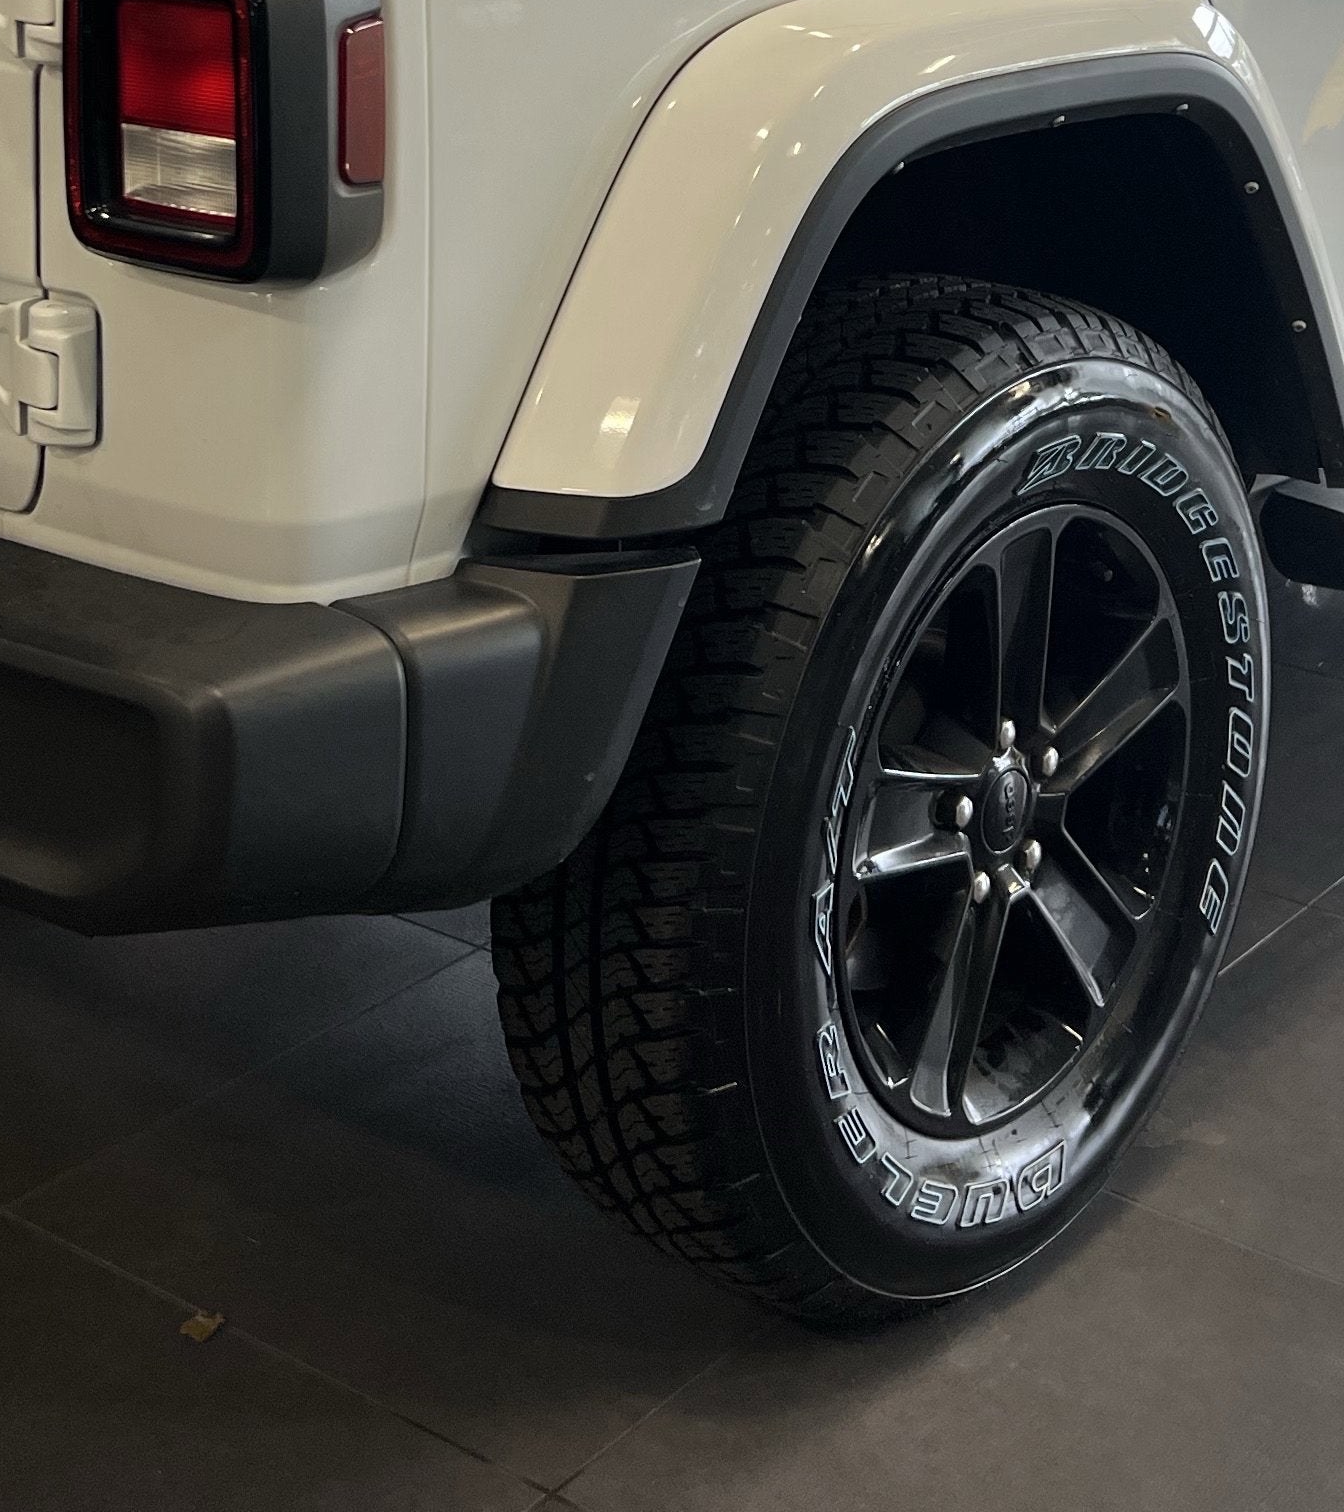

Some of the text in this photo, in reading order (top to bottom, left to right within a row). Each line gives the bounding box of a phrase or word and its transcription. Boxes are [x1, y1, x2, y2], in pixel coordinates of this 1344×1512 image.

[1016, 431, 1258, 936] BRIDGESTONE
[811, 725, 1067, 1228] DUELER A/T
